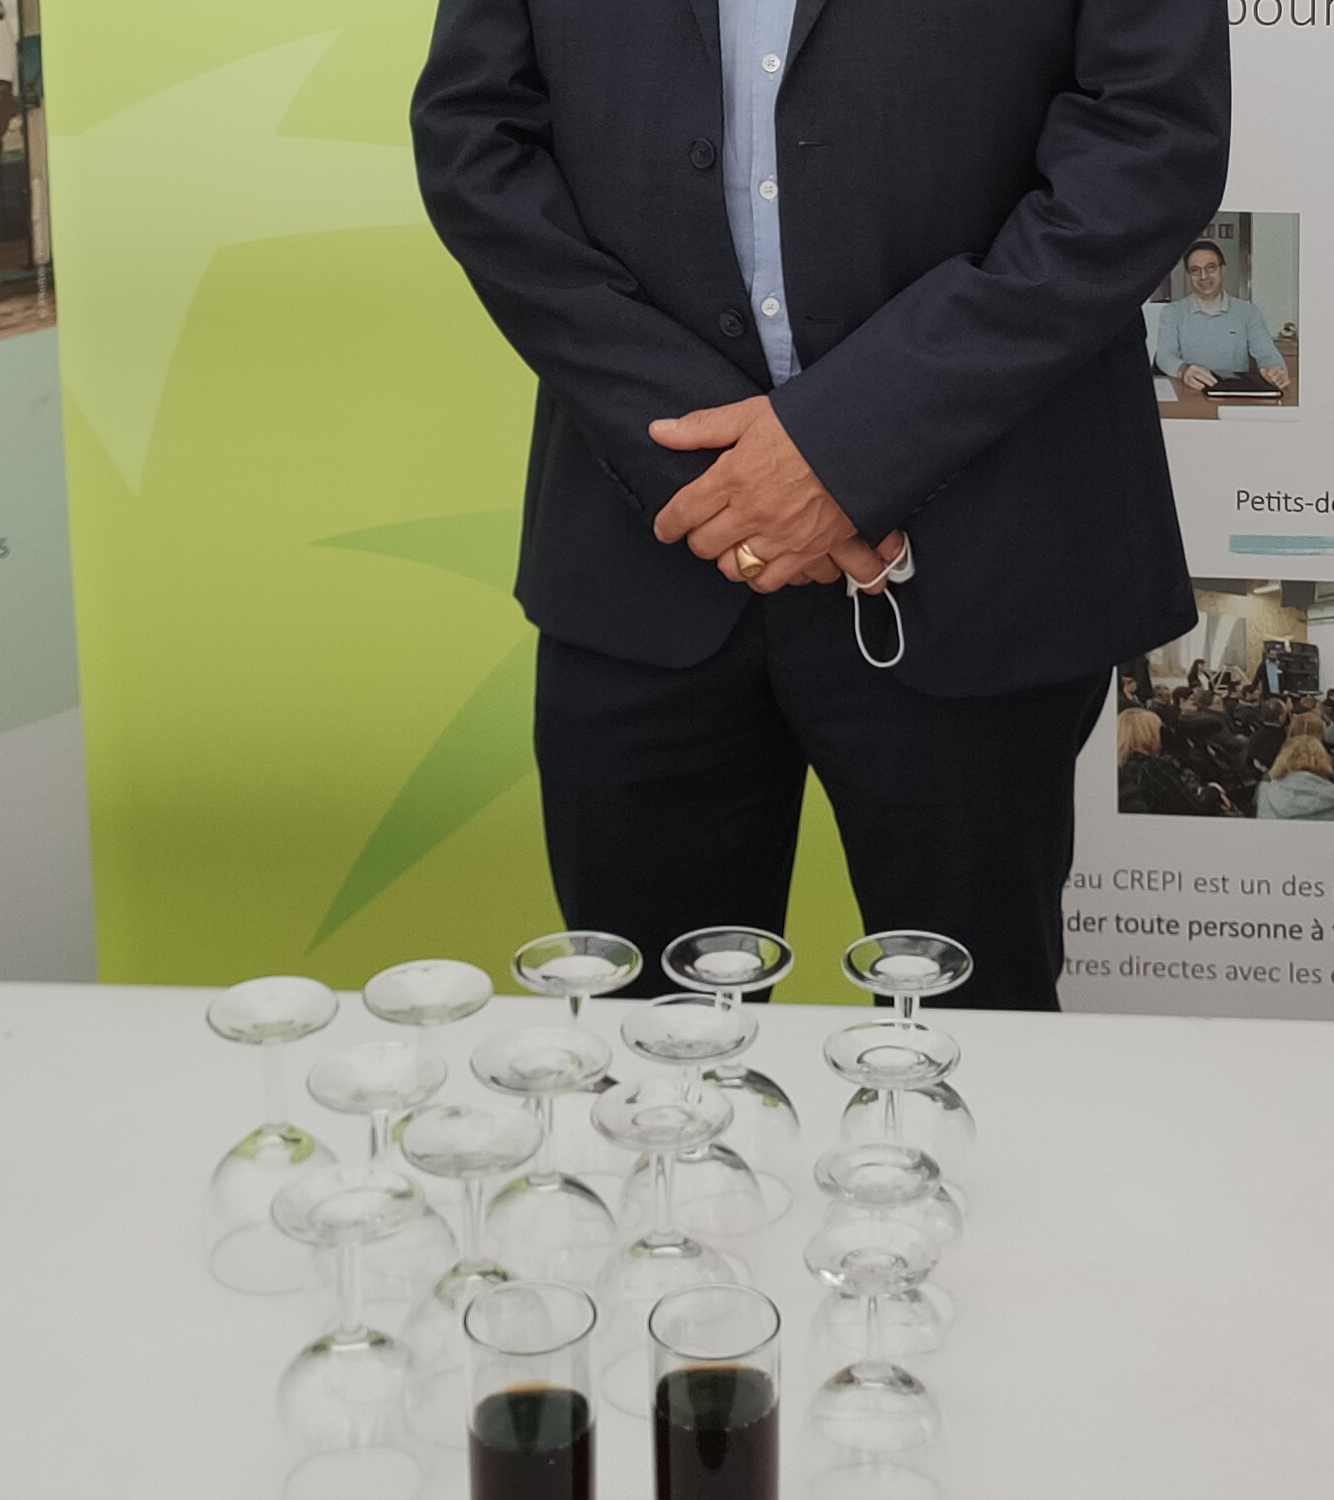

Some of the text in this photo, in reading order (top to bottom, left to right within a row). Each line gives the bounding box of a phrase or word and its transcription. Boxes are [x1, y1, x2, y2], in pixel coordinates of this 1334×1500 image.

[1112, 868, 1183, 892] CREPI
[1193, 875, 1230, 895] est
[1240, 878, 1272, 896] un
[1282, 875, 1325, 898] des
[1115, 913, 1180, 935] toute
[1188, 919, 1303, 941] personne
[1310, 917, 1324, 941] à
[1118, 955, 1218, 981] directes
[1225, 963, 1281, 983] avec
[1289, 961, 1322, 984] les
